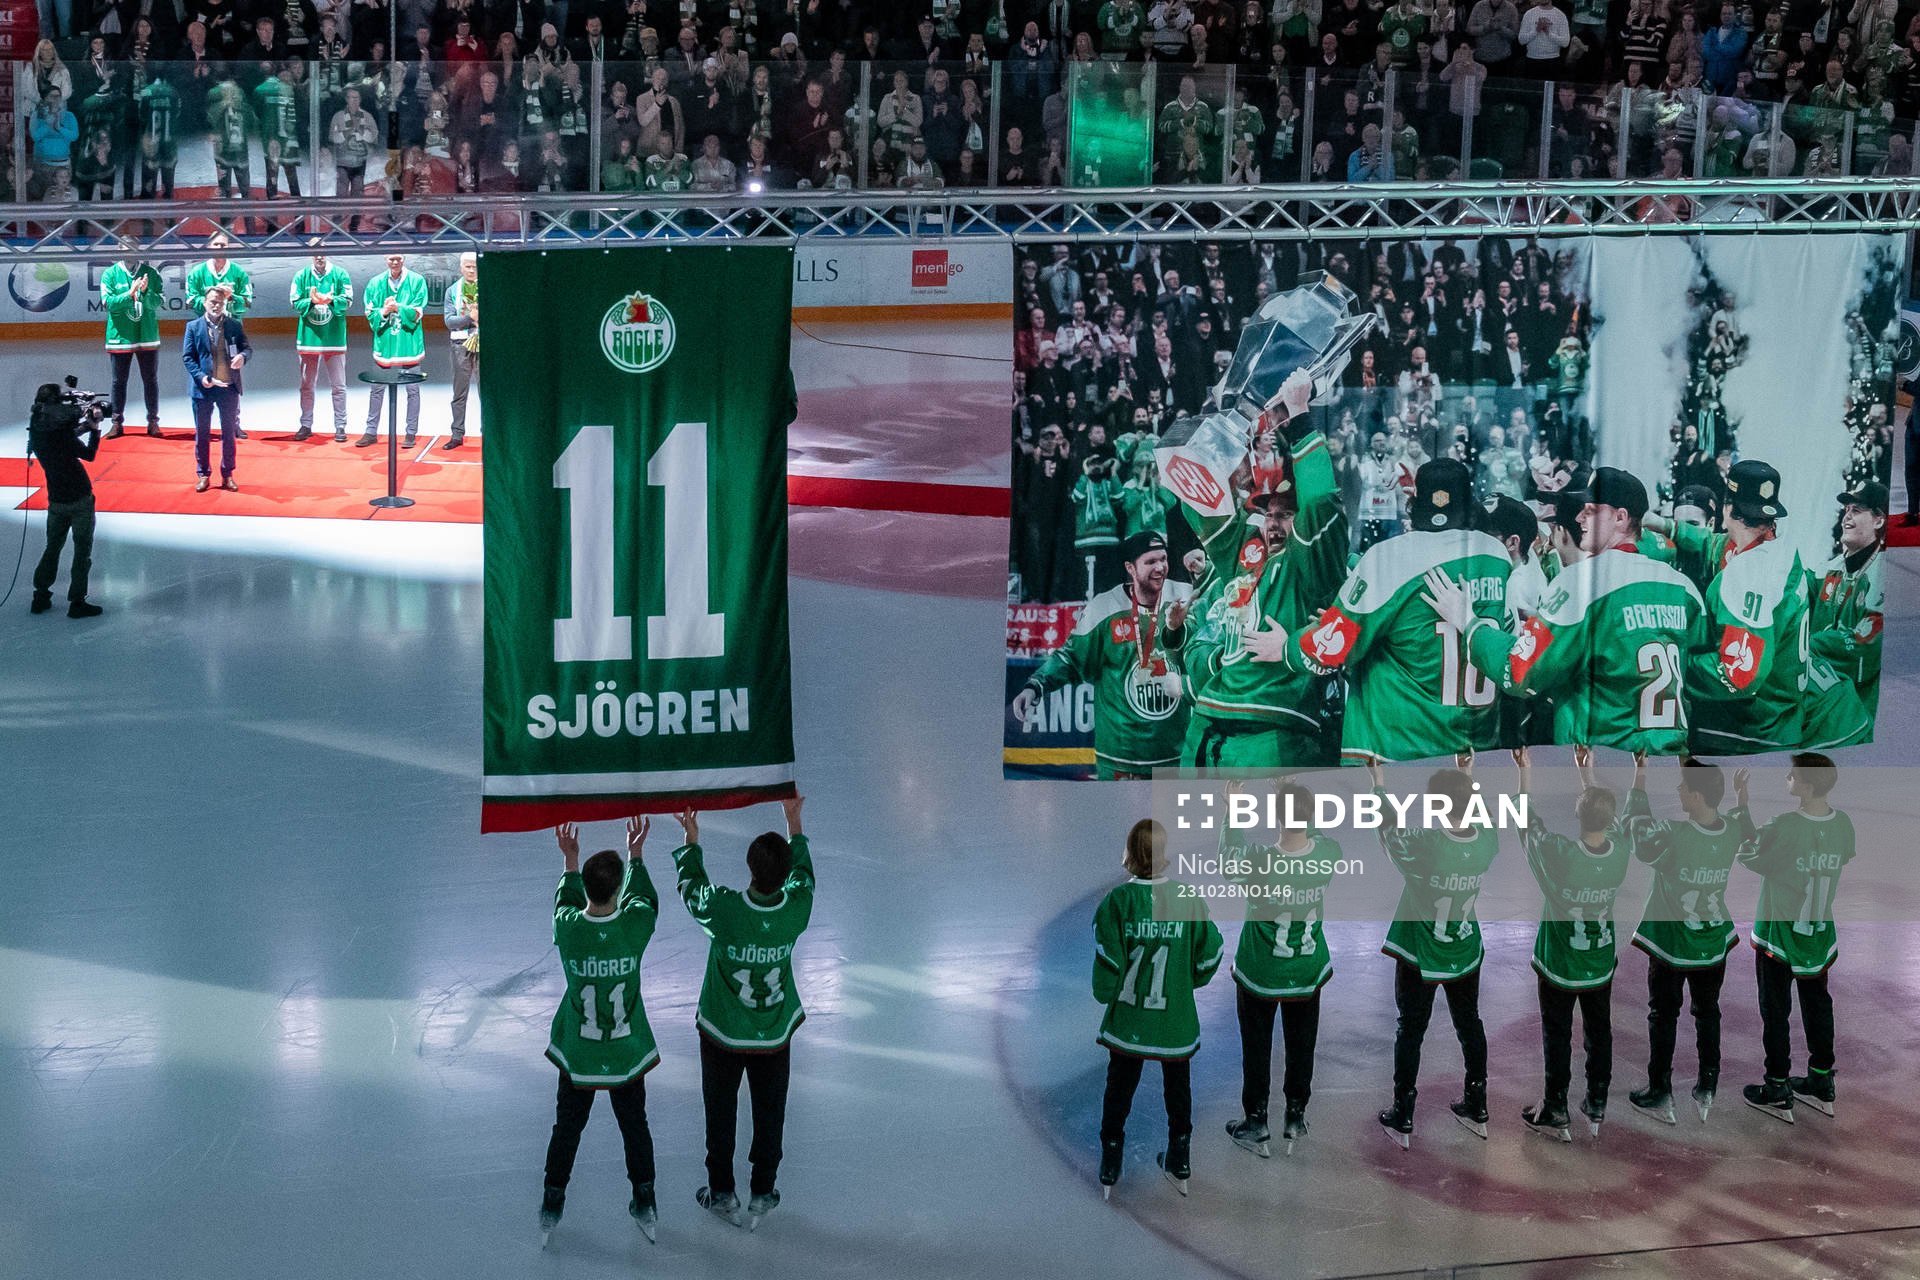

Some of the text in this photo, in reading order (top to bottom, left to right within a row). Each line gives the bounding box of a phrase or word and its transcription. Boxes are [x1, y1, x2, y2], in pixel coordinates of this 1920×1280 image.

[915, 262, 964, 276] menigo
[612, 327, 664, 365] RÖGLE
[1170, 461, 1220, 503] CHL
[553, 422, 725, 662] 11
[1470, 576, 1504, 602] BERG
[1742, 590, 1763, 622] 91
[526, 680, 750, 740] SJÖGREN
[1022, 682, 1096, 733] ANG
[1793, 876, 1831, 937] 11
[1124, 918, 1184, 939] SJÖGREN
[1272, 908, 1318, 958] 11
[569, 955, 637, 978] SJÖGREN
[727, 942, 793, 965] SJÖGREN
[731, 967, 785, 1009] 11
[1117, 945, 1169, 1010] 11
[579, 981, 632, 1041] 11
